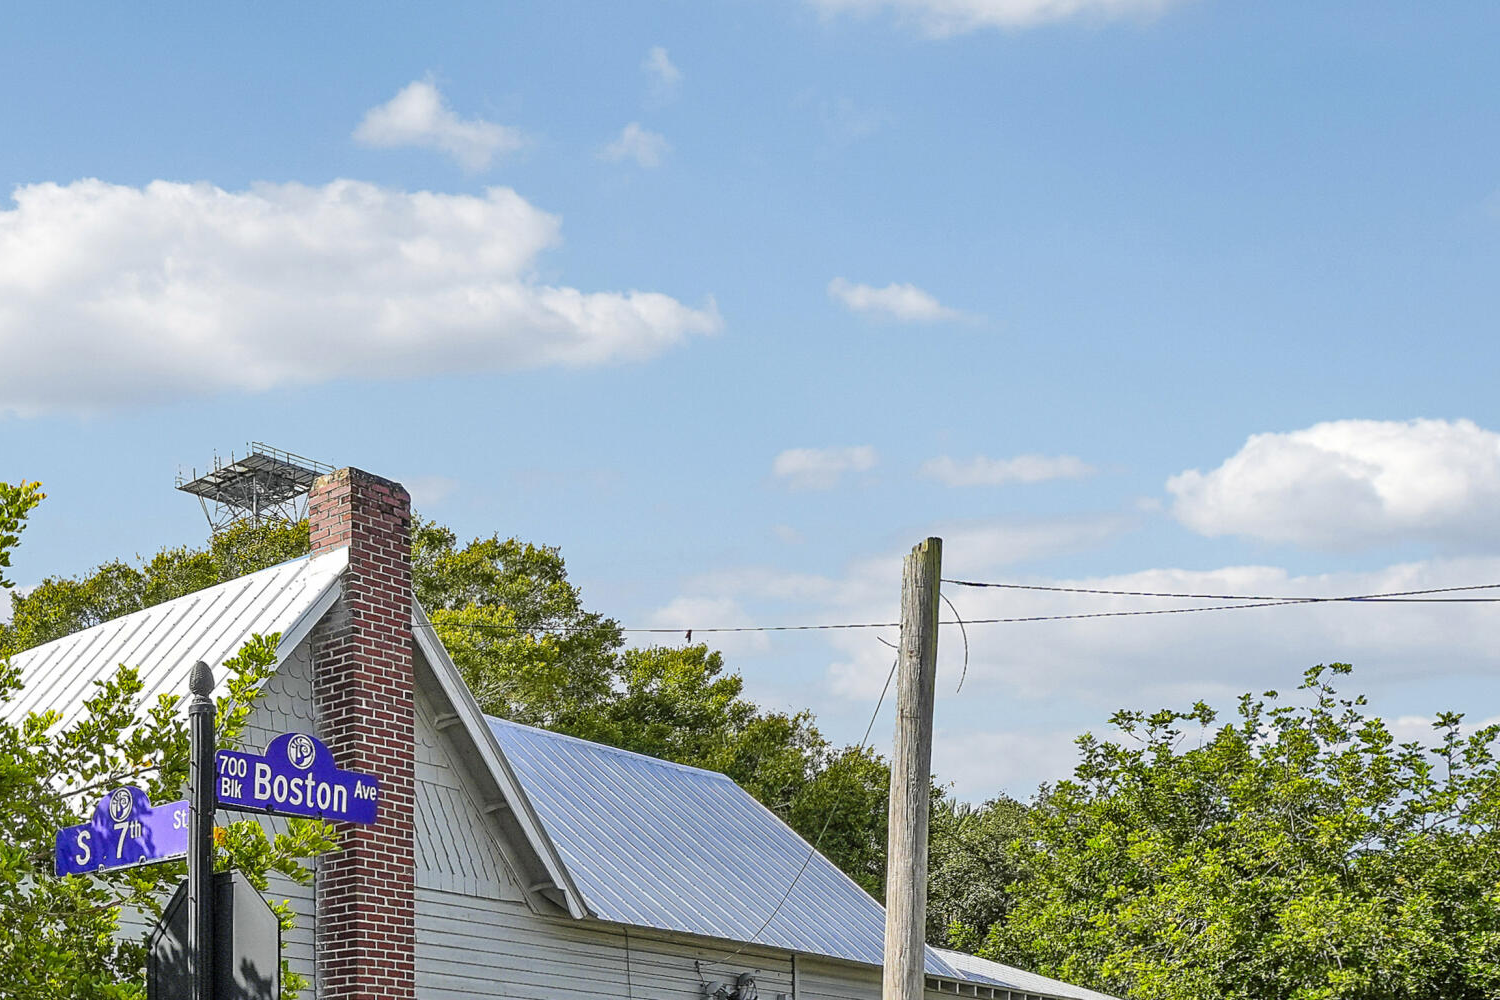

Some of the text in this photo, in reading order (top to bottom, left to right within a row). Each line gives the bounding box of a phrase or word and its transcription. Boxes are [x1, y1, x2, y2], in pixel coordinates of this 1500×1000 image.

[219, 755, 247, 778] 700
[221, 777, 242, 799] Blk
[254, 762, 377, 813] Boston Ave
[75, 808, 190, 866] S 7th St
